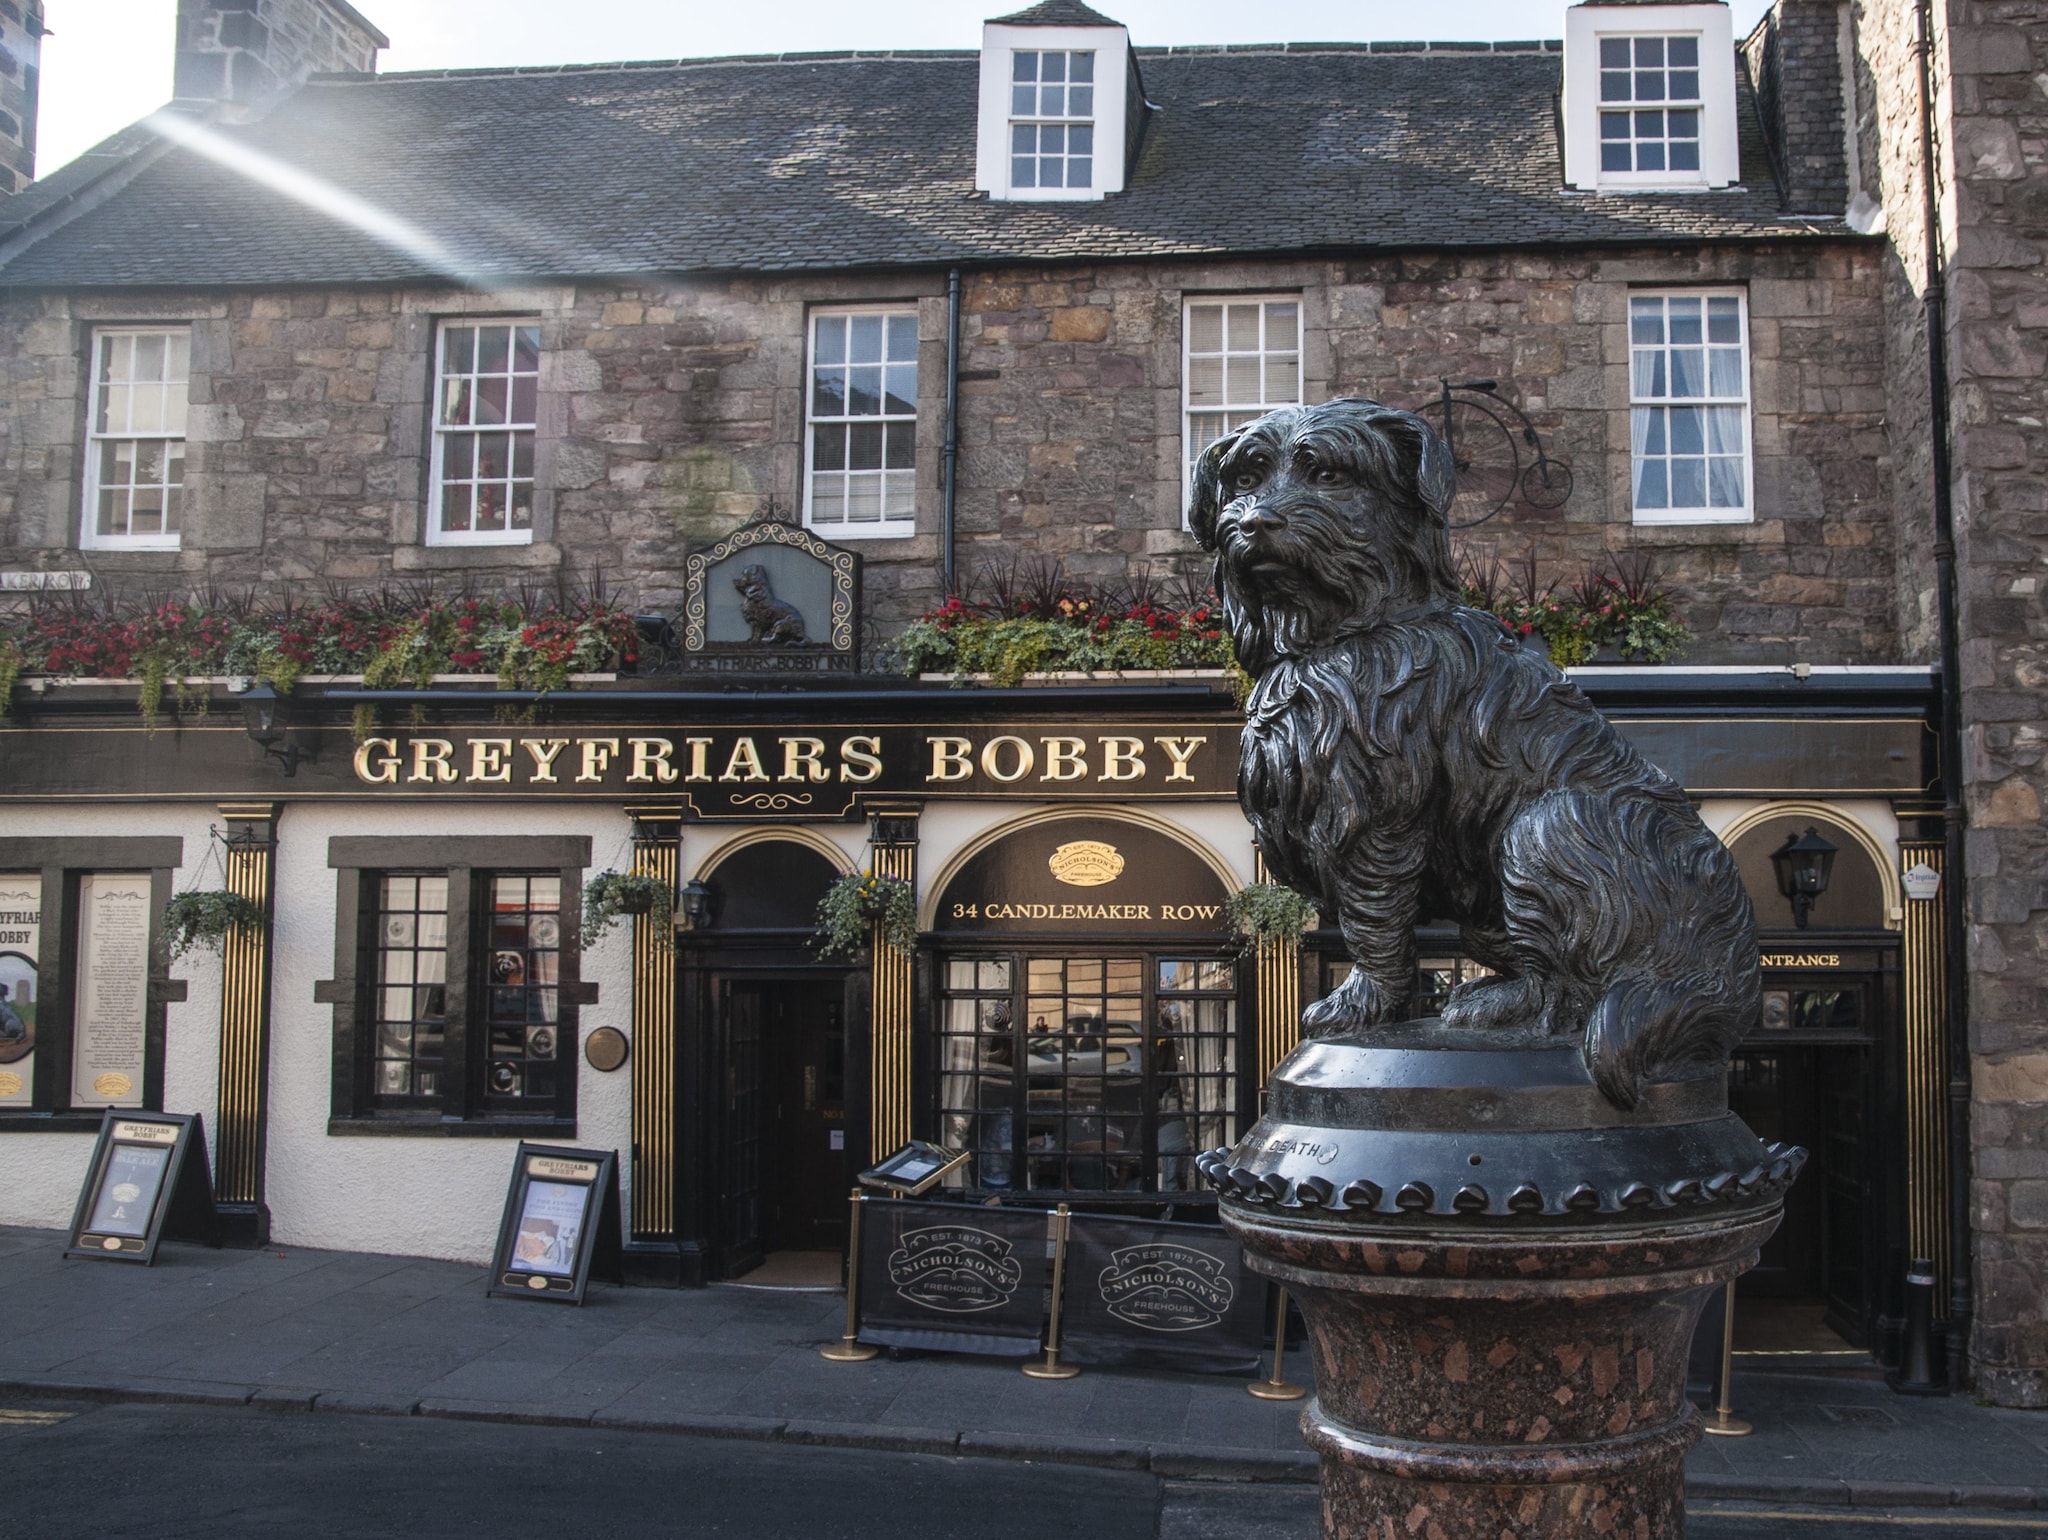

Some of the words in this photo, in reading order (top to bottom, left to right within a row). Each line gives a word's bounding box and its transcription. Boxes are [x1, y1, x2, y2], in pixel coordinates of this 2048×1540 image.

[777, 655, 821, 670] BOBBY
[828, 655, 850, 670] INN
[353, 735, 884, 784] GREYFRIARS
[925, 734, 1208, 784] BOBBY
[1059, 856, 1115, 870] NICHOLSON'S
[953, 903, 978, 919] 34
[985, 903, 1151, 920] CANDLEMAKER
[1161, 905, 1219, 920] ROW
[1269, 1140, 1320, 1156] DEATH
[538, 1160, 589, 1171] GREYFRIARS
[958, 1233, 982, 1244] 1873
[1169, 1251, 1194, 1264] 1873
[902, 1255, 1008, 1284] NICHOLSON'S
[923, 1283, 984, 1294] FREEHOUSE
[1112, 1274, 1220, 1304] NICHOLSON'S
[1134, 1301, 1195, 1312] FREEHOUSE
